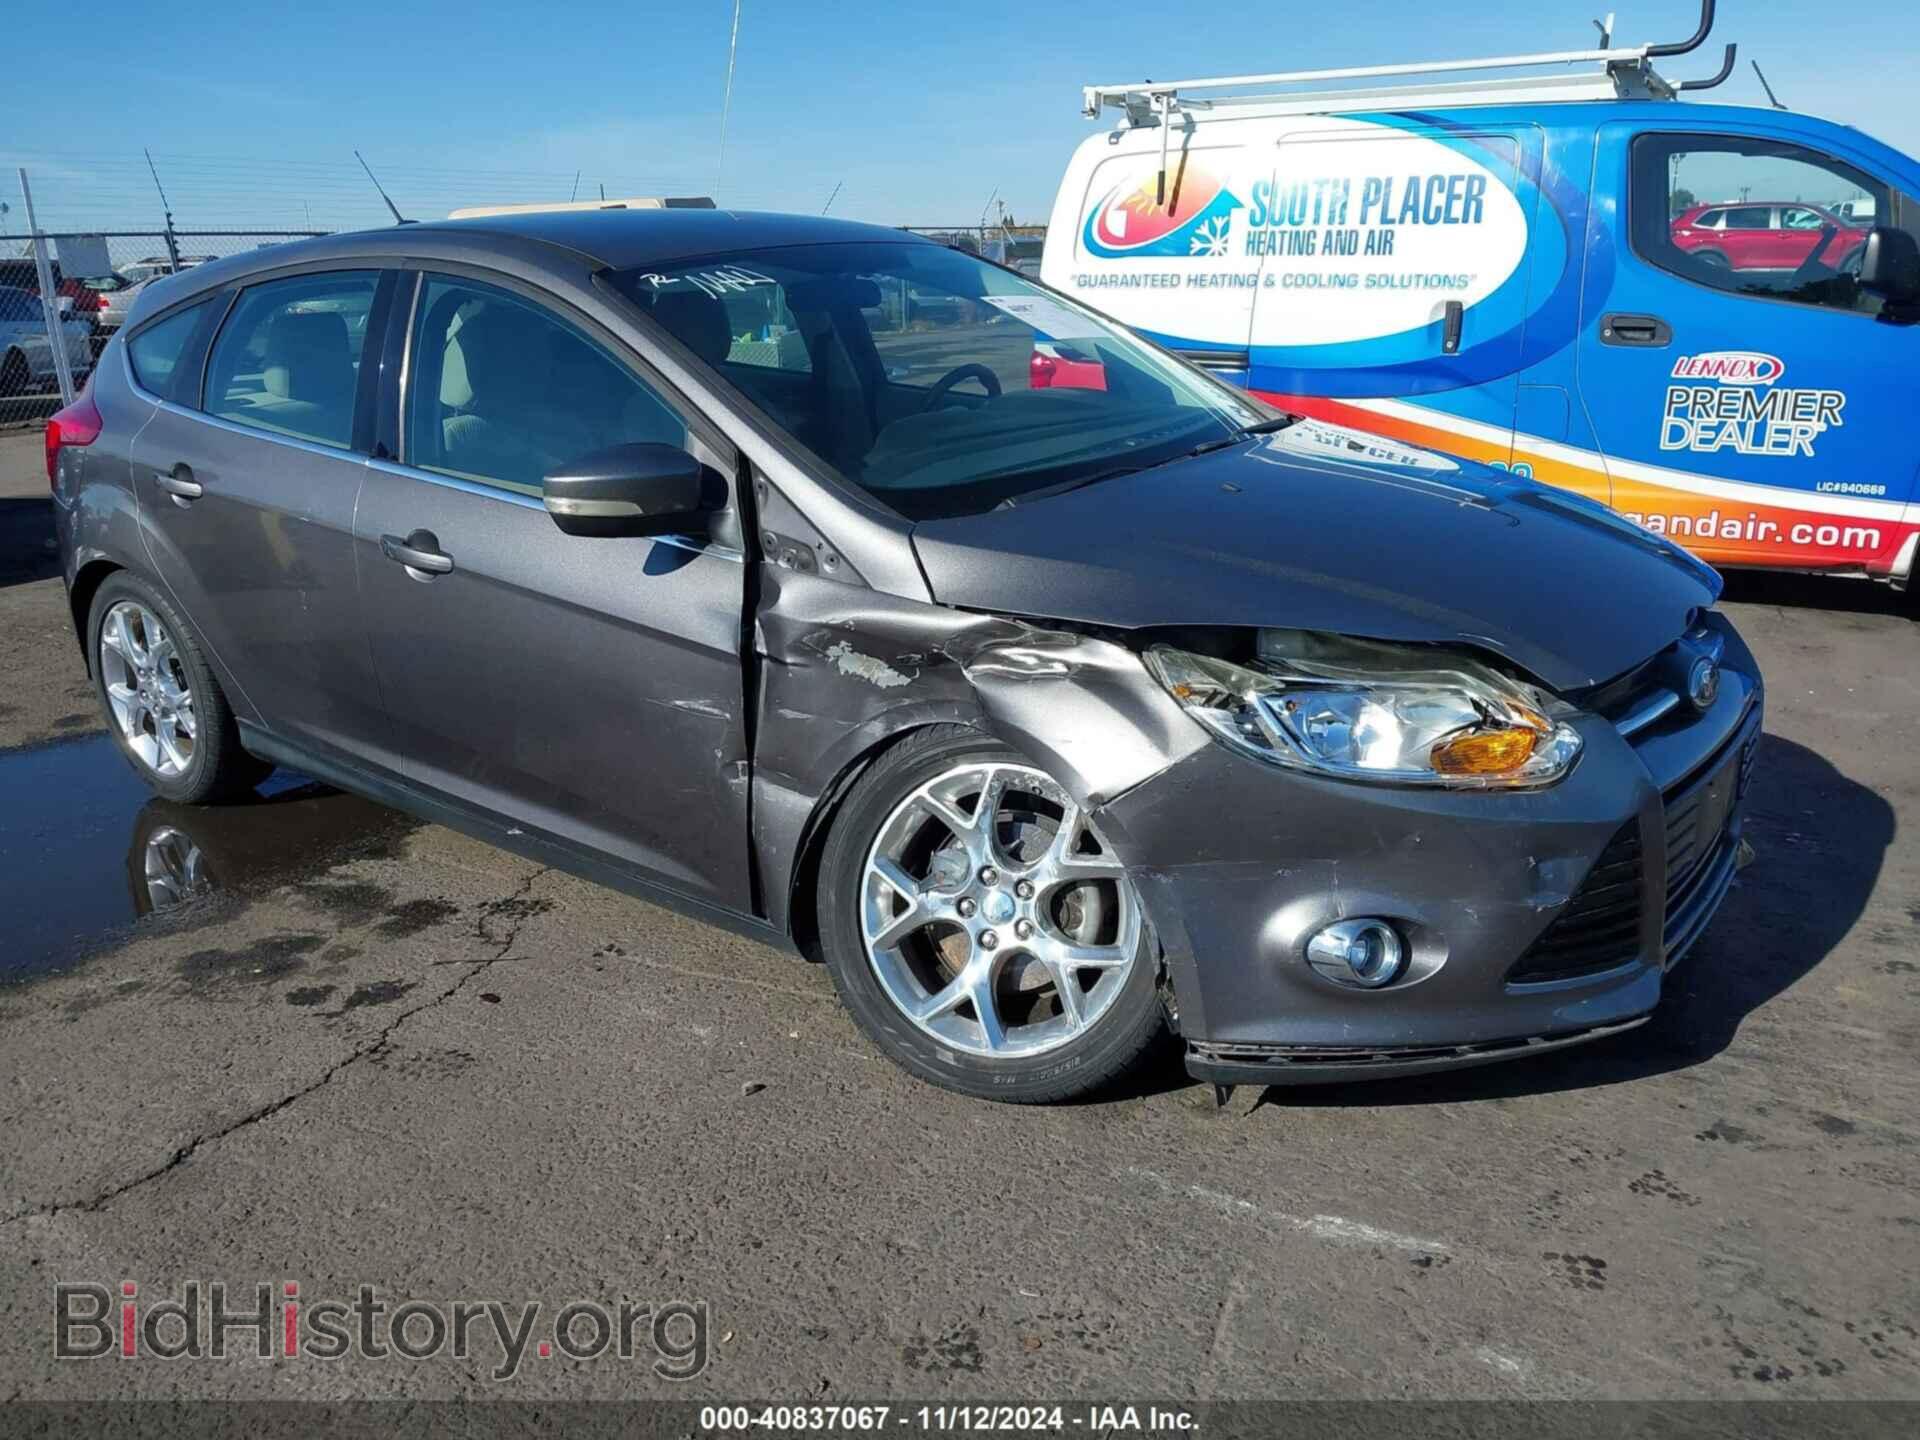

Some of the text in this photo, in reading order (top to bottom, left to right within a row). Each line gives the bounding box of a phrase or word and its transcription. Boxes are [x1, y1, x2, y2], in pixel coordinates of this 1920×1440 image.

[1250, 174, 1487, 227] SOUTH PLACER
[1245, 229, 1395, 256] HEATING AND AIR
[1187, 273, 1258, 289] HEATING
[1263, 274, 1275, 288] &
[1281, 273, 1359, 288] COOLING
[1673, 357, 1761, 378] LENNOX
[1665, 387, 1844, 425] PREMIER
[1660, 418, 1815, 457] DEALER
